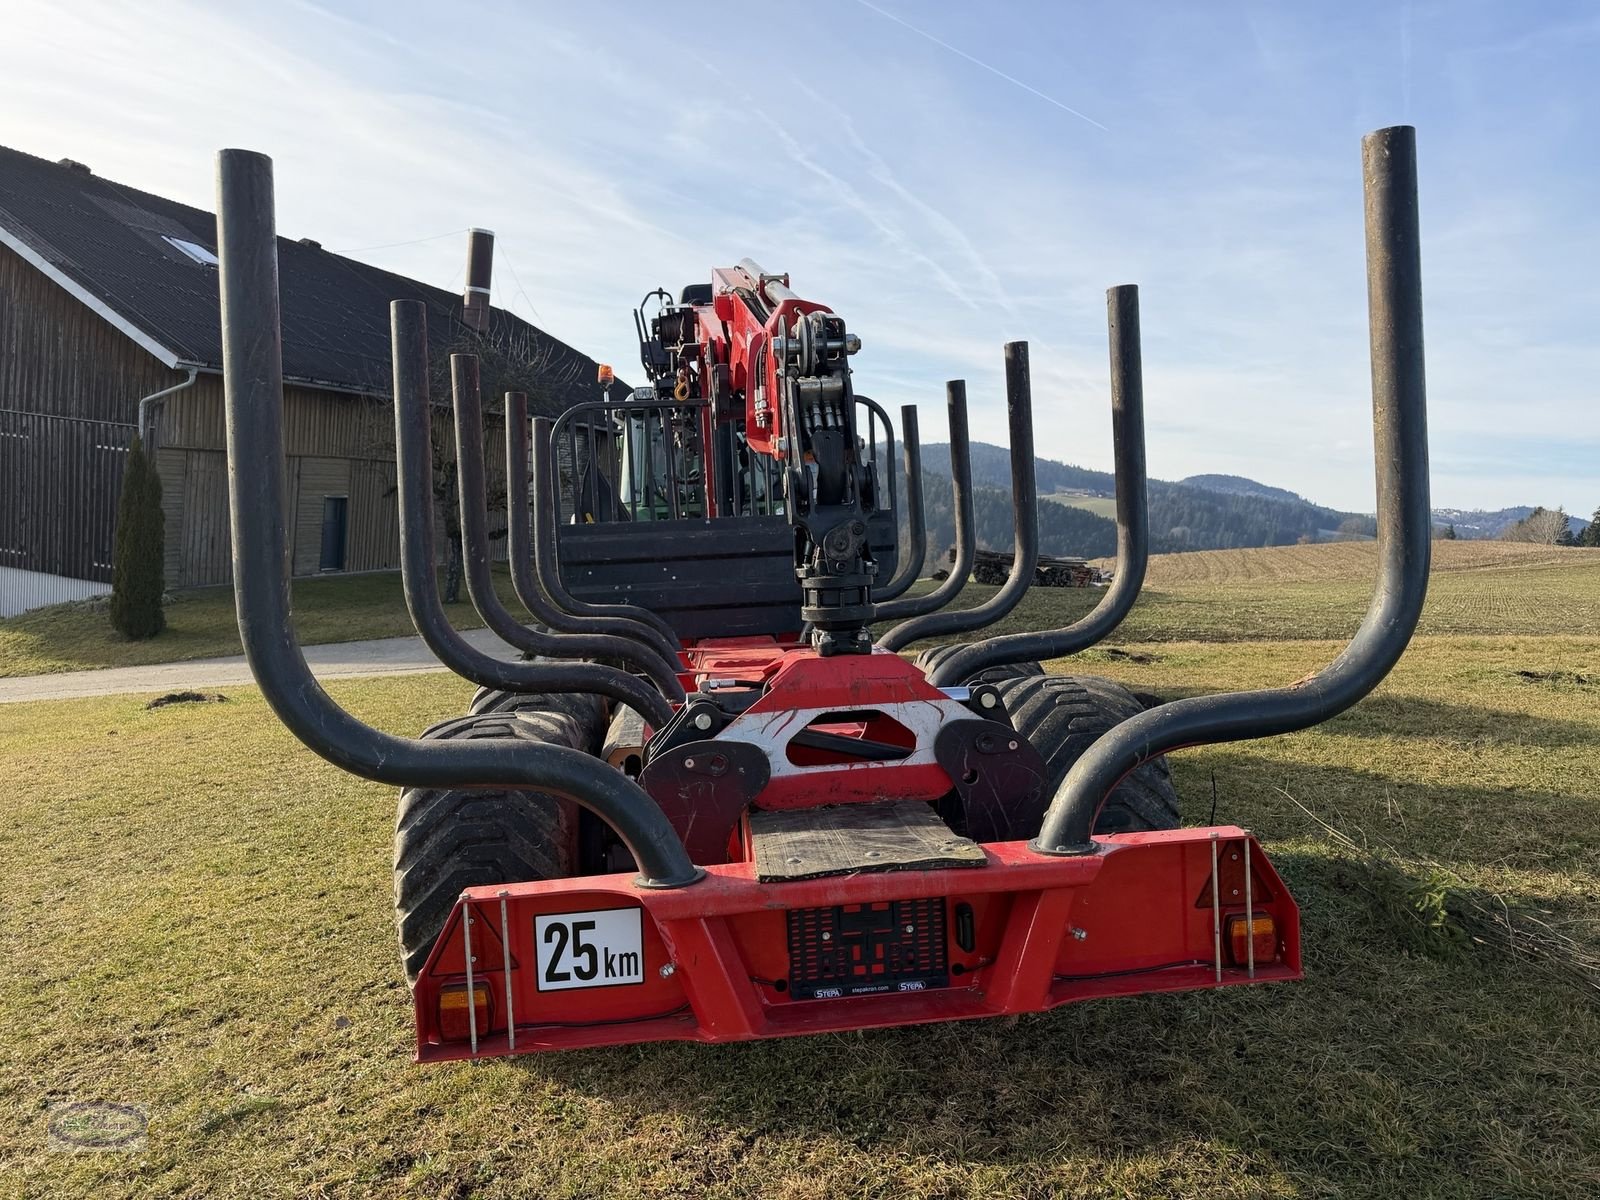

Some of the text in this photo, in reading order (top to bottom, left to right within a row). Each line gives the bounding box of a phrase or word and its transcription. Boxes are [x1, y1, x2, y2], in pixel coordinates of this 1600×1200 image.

[544, 920, 639, 982] 25 km
[900, 982, 924, 990] STEPA
[816, 989, 840, 998] STEPA
